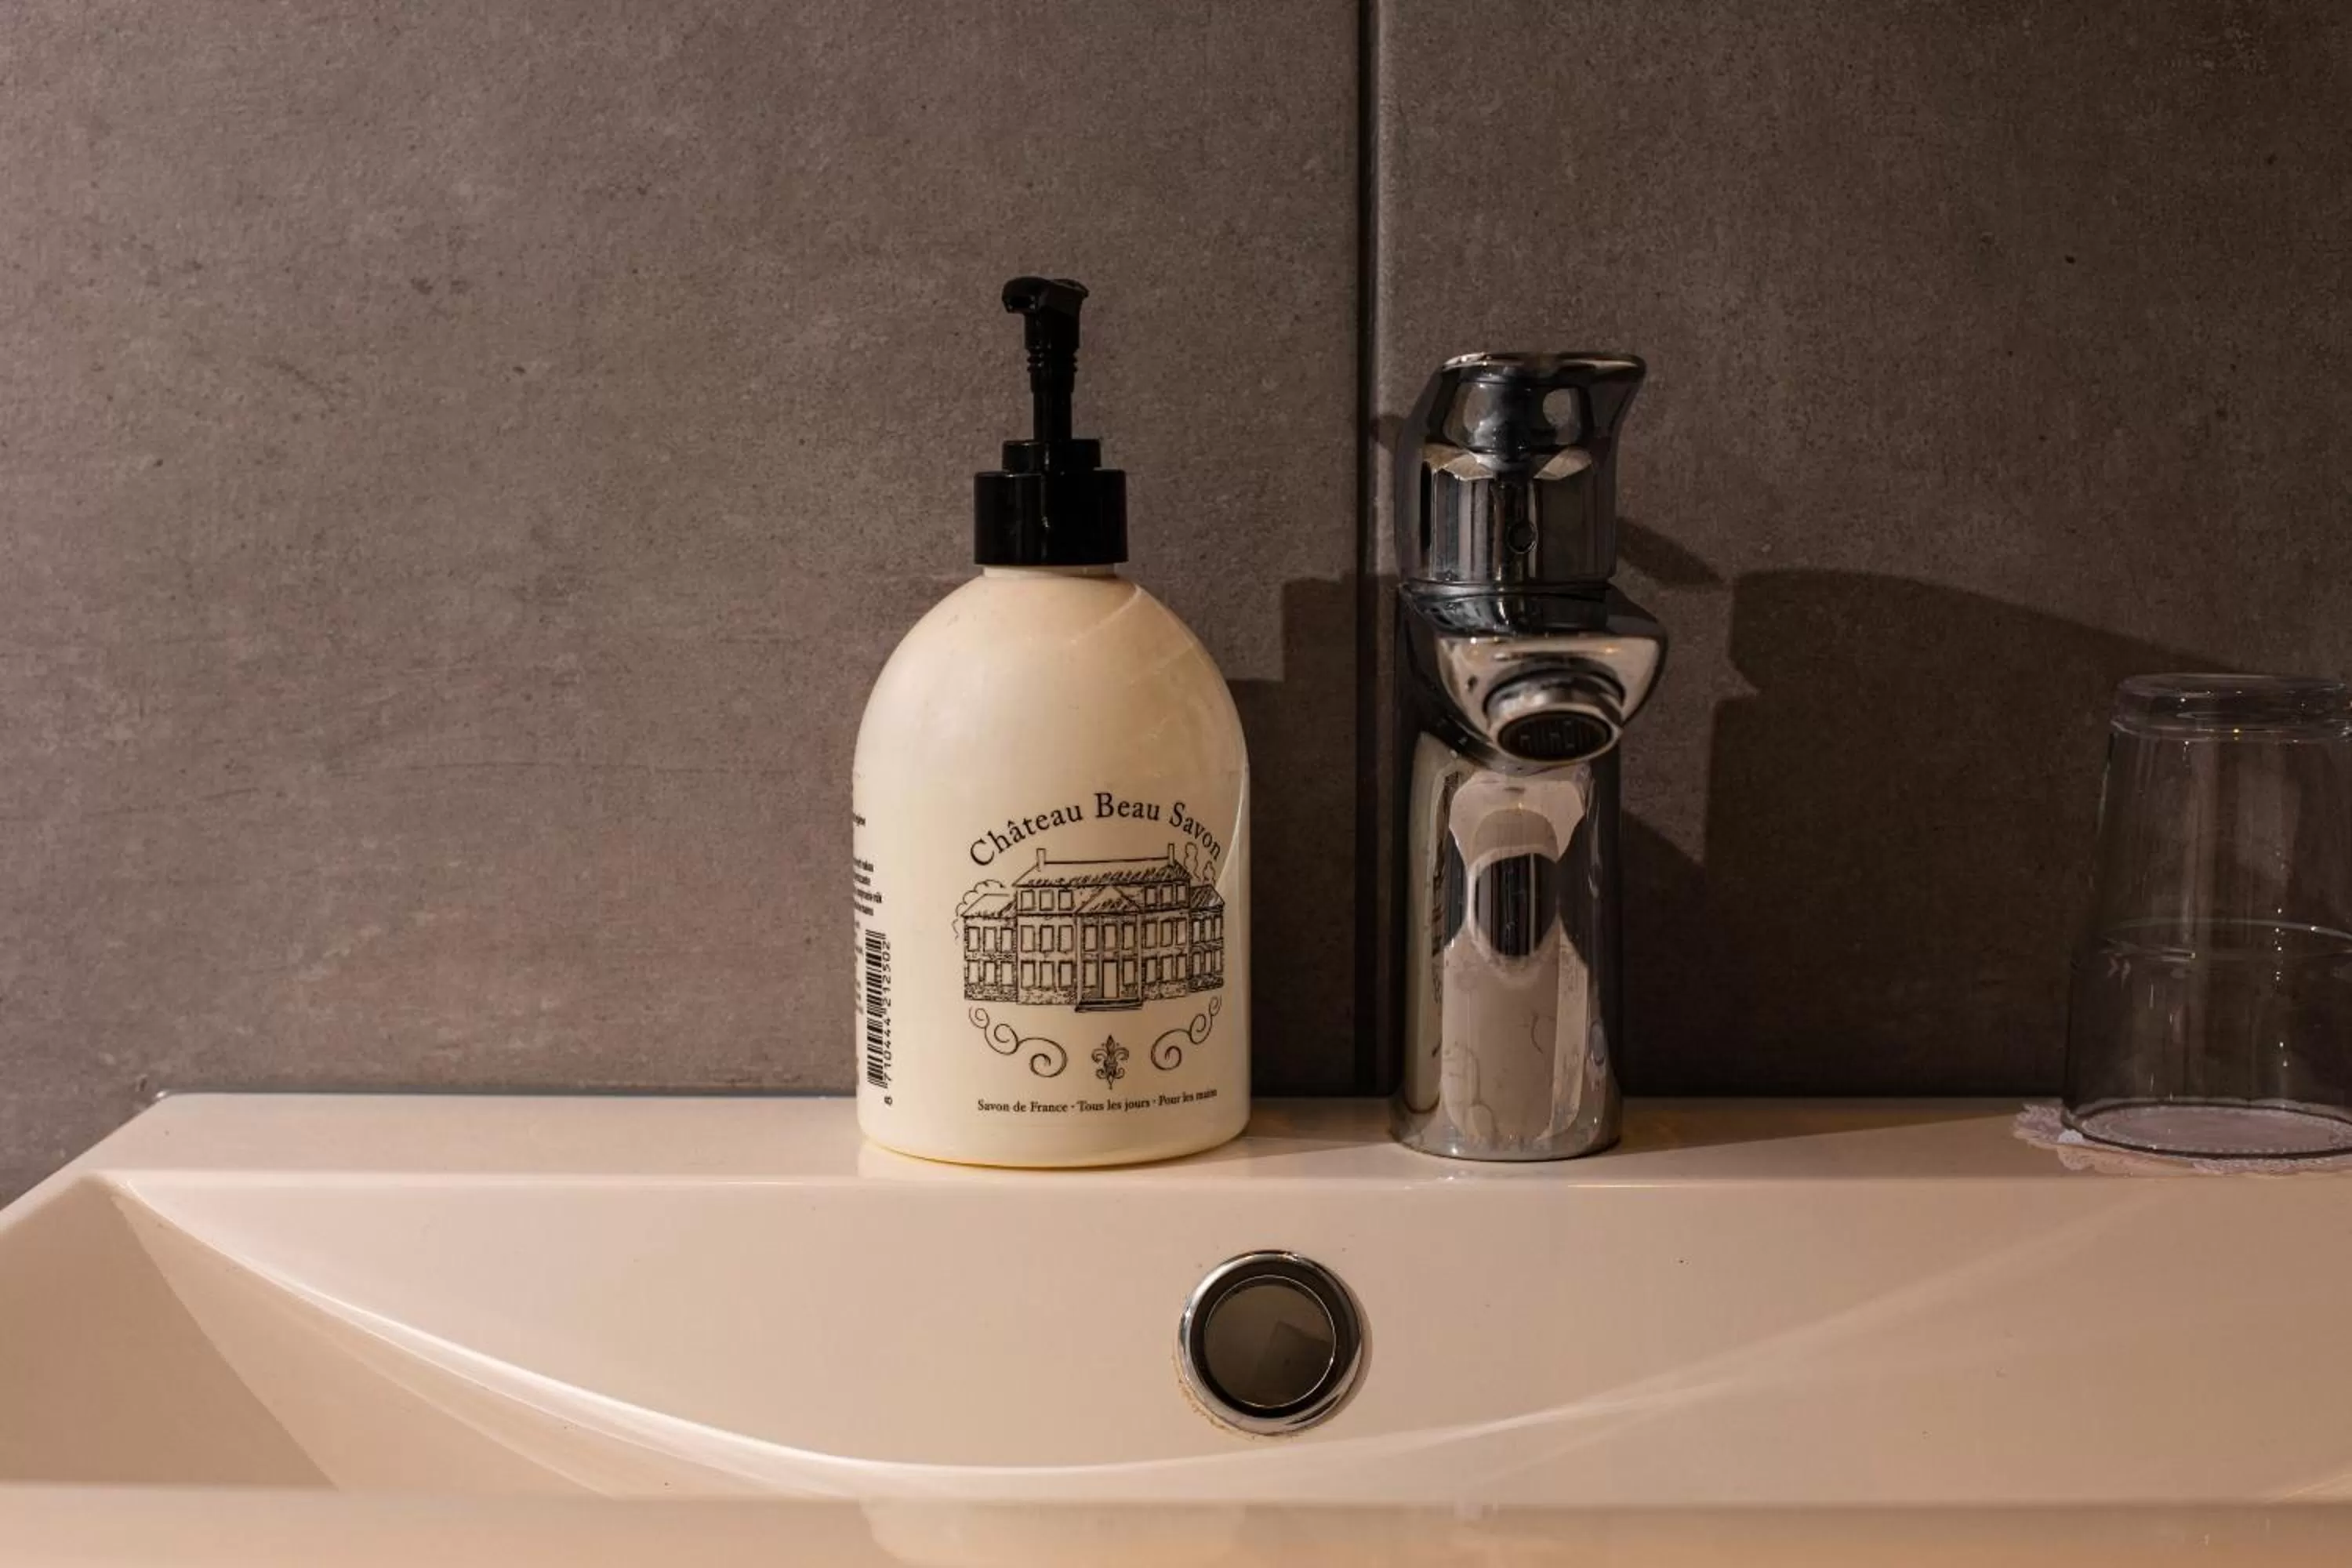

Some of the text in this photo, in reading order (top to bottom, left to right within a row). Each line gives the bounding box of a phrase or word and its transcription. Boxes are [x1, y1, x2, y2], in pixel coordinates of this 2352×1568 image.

[969, 792, 1221, 866] Château Beau Savon
[882, 940, 891, 1007] 212502
[884, 1018, 892, 1083] 710444
[978, 1099, 1010, 1112] Savon
[1013, 1100, 1026, 1112] de
[1030, 1101, 1068, 1112] France
[1076, 1100, 1104, 1112] Tous
[1107, 1098, 1122, 1111] les
[1159, 1094, 1180, 1106] Pour
